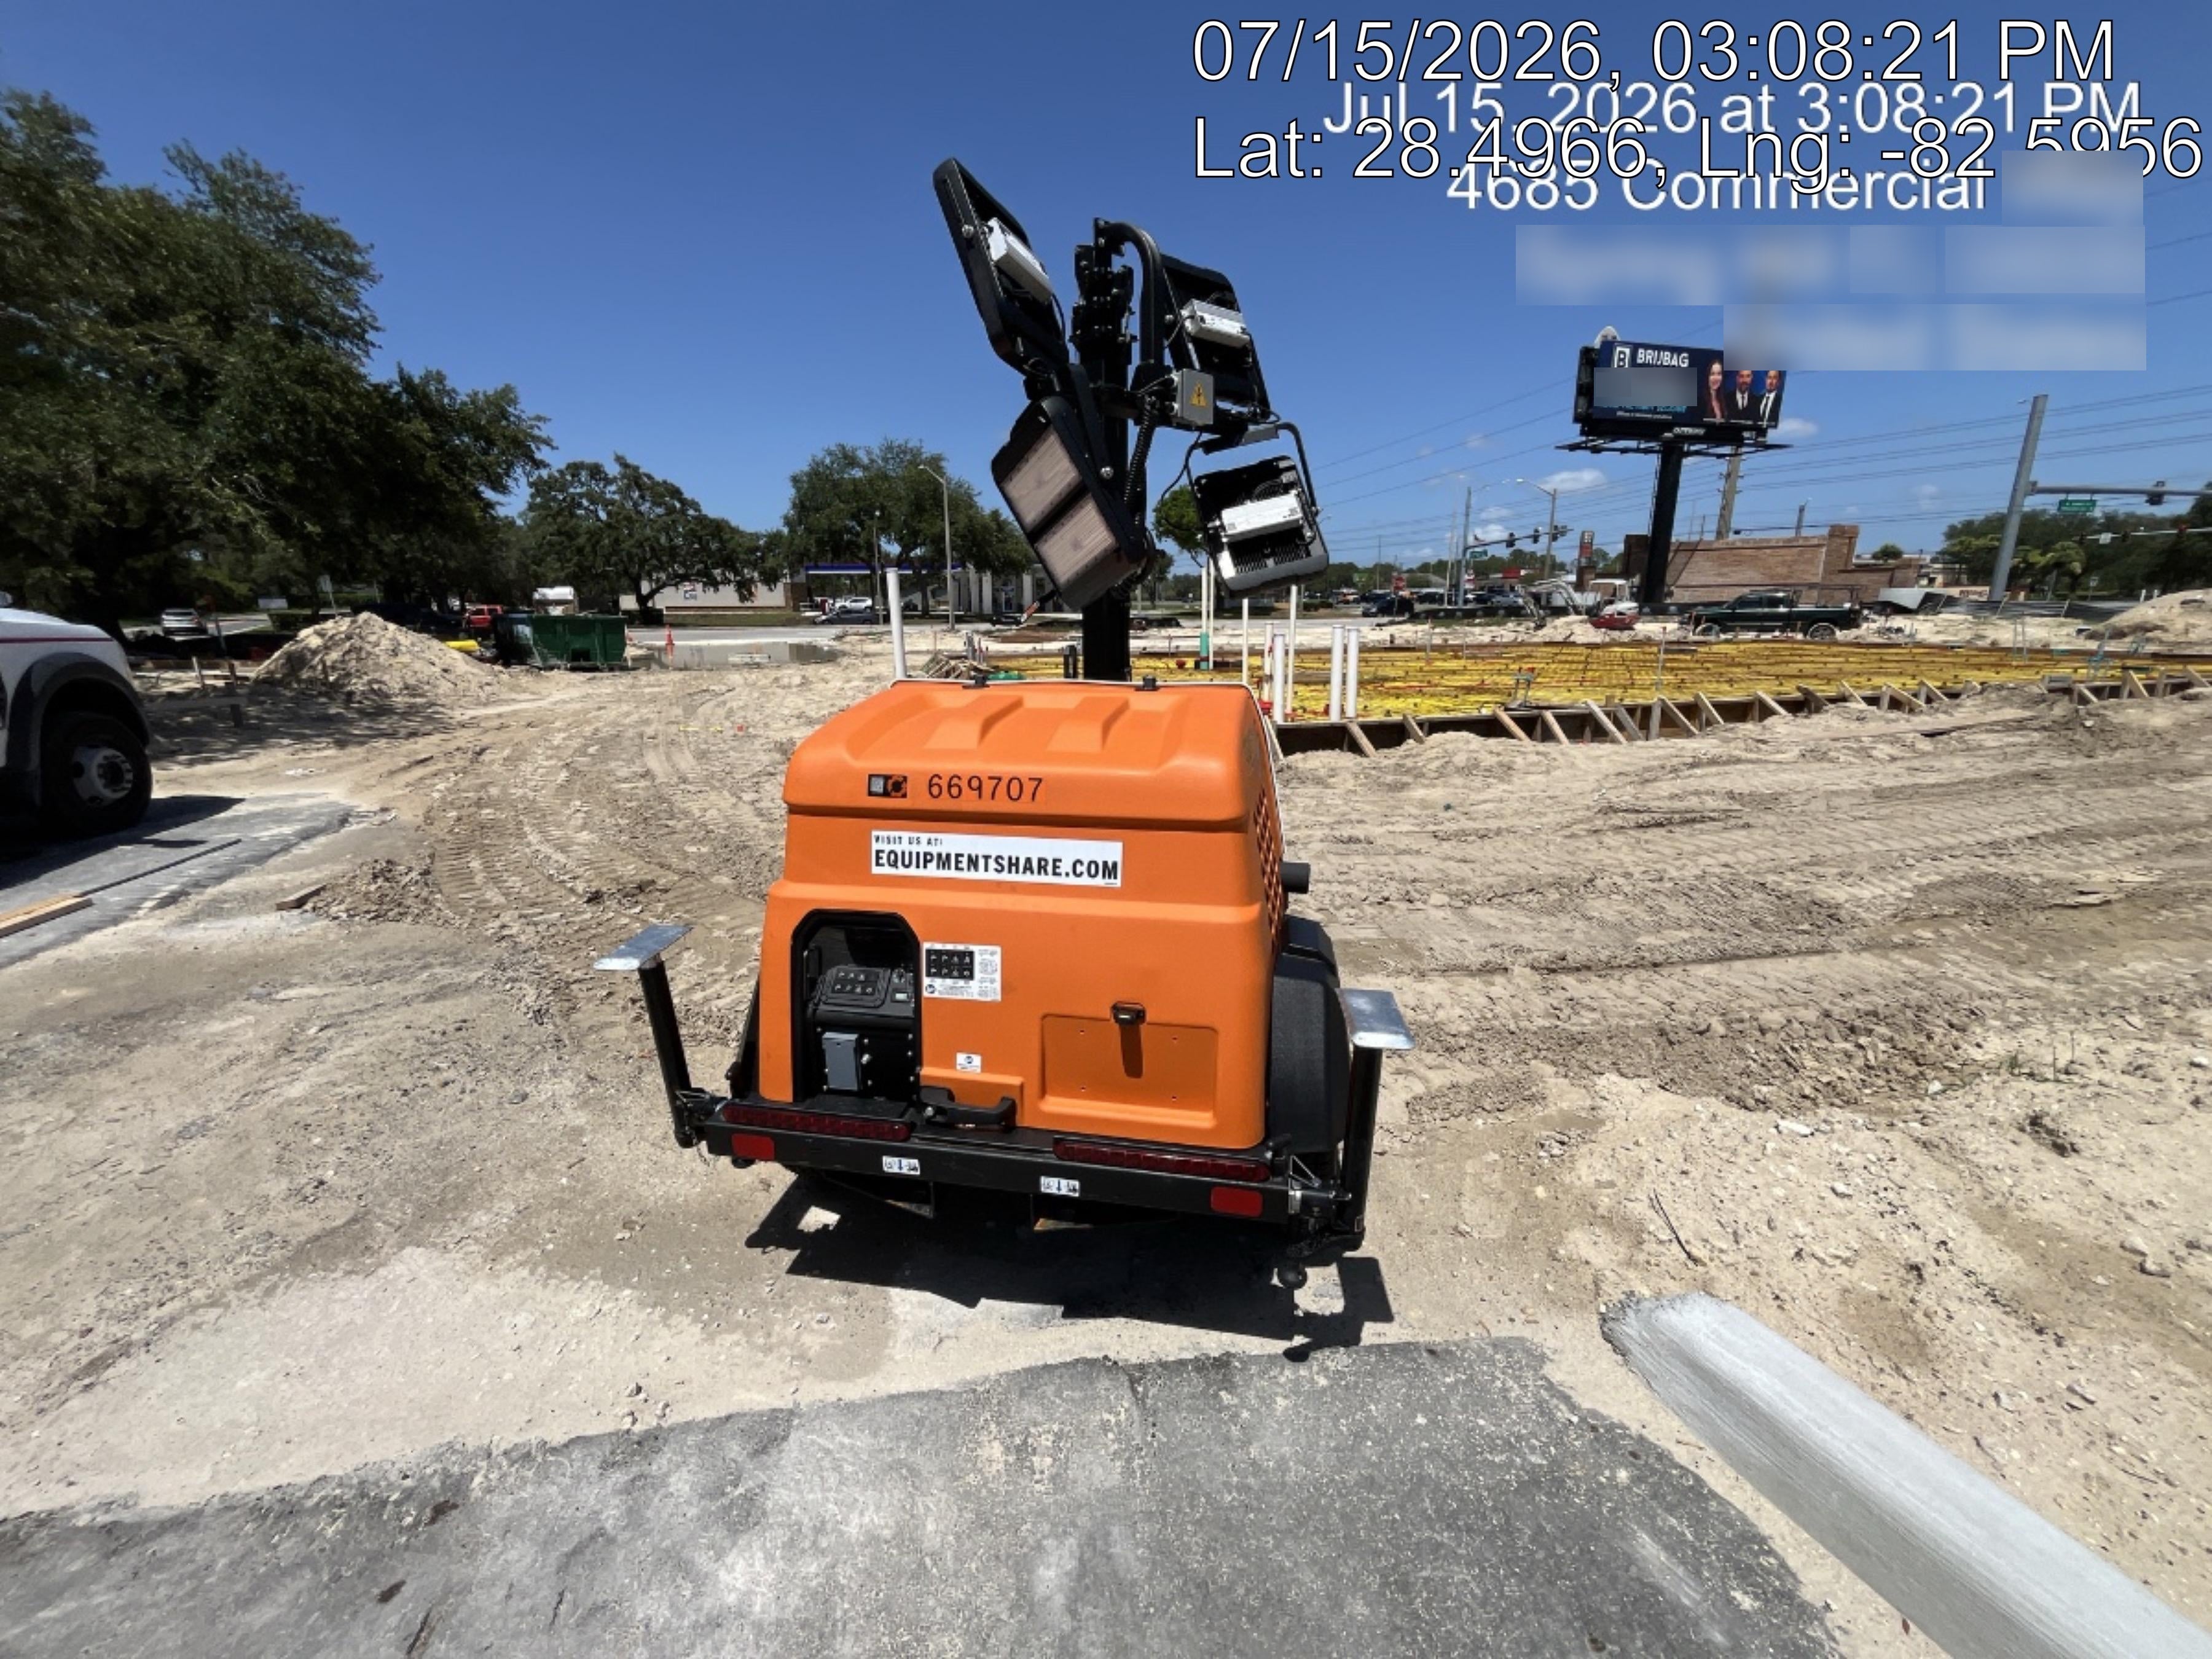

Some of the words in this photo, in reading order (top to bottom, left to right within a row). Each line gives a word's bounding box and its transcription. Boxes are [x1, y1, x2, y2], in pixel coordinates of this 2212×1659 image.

[1636, 348, 1690, 367] BRIJBAG
[928, 774, 1043, 802] 669707
[874, 834, 903, 845] VISIT
[908, 836, 922, 845] US
[874, 849, 1118, 880] EQUIPMENTSHARE.COM
